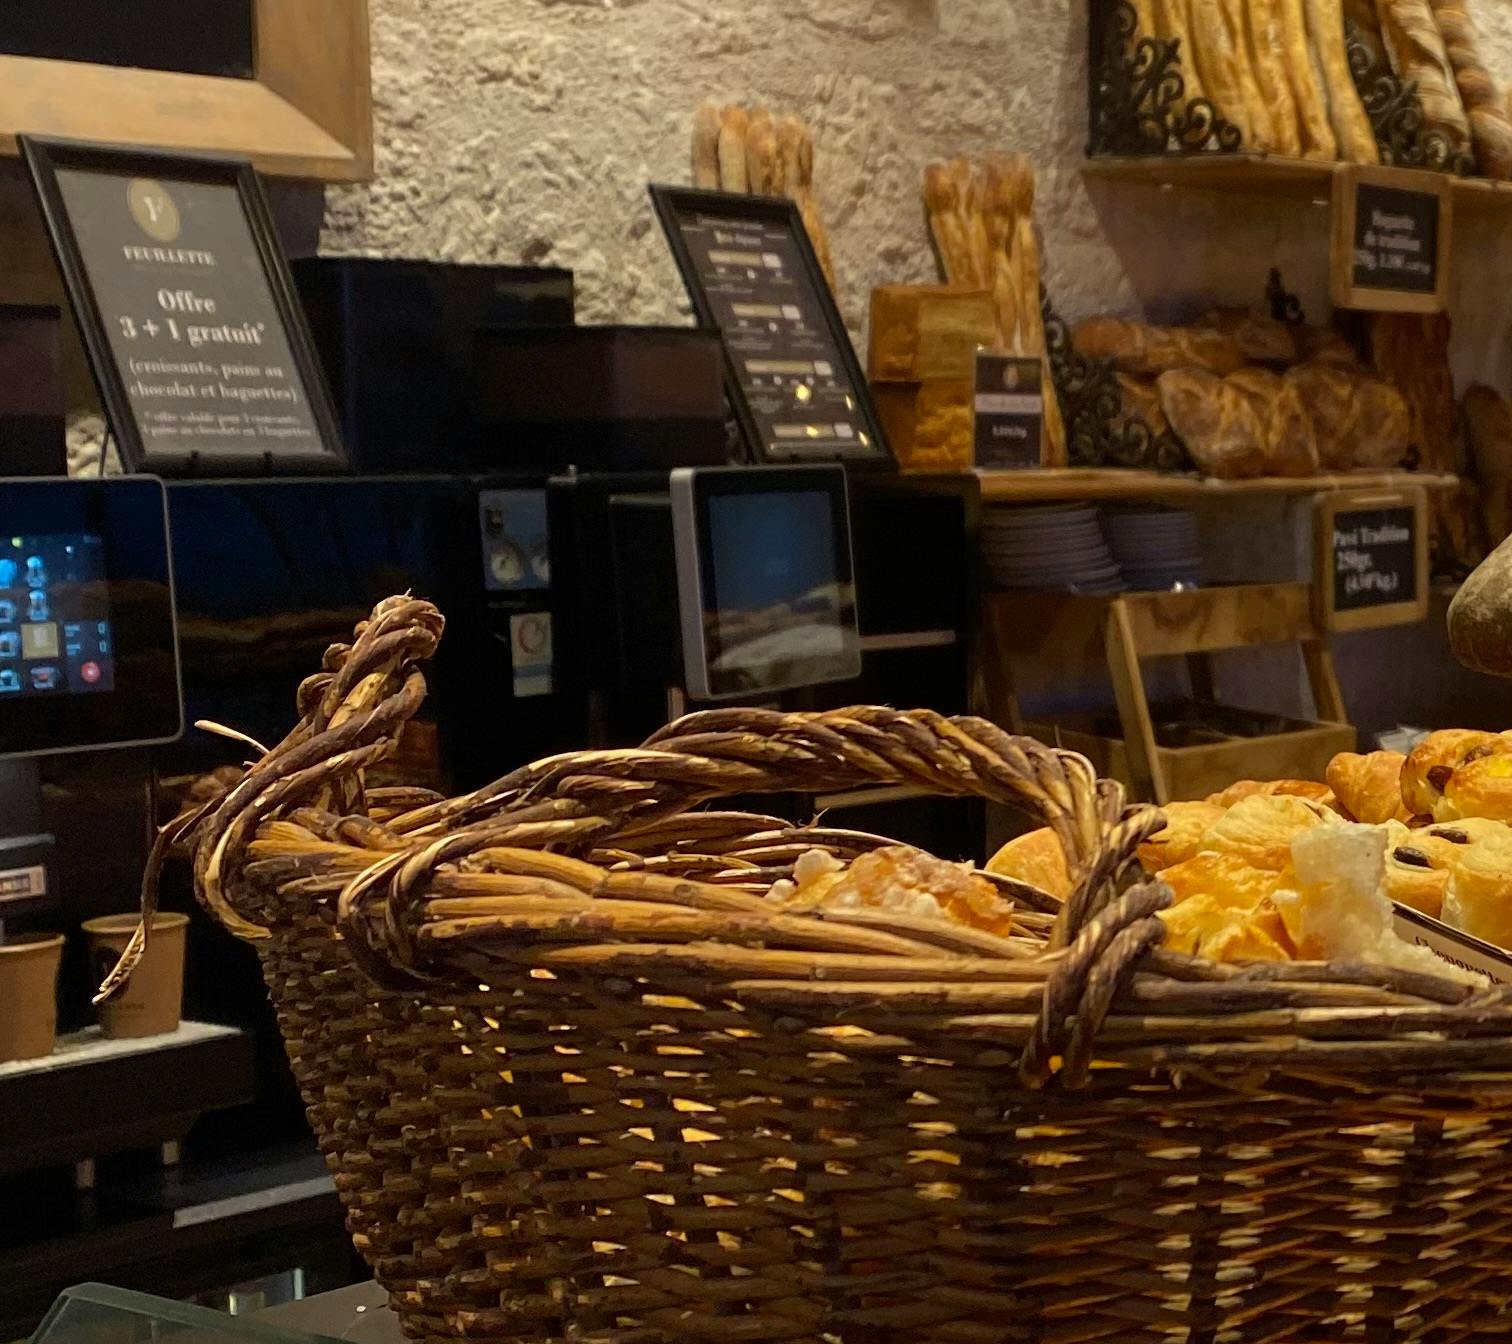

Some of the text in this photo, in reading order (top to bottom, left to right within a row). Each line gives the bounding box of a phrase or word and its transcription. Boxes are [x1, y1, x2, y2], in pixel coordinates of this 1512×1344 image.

[156, 288, 217, 314] Offre
[119, 315, 138, 339] 3
[142, 319, 160, 338] +
